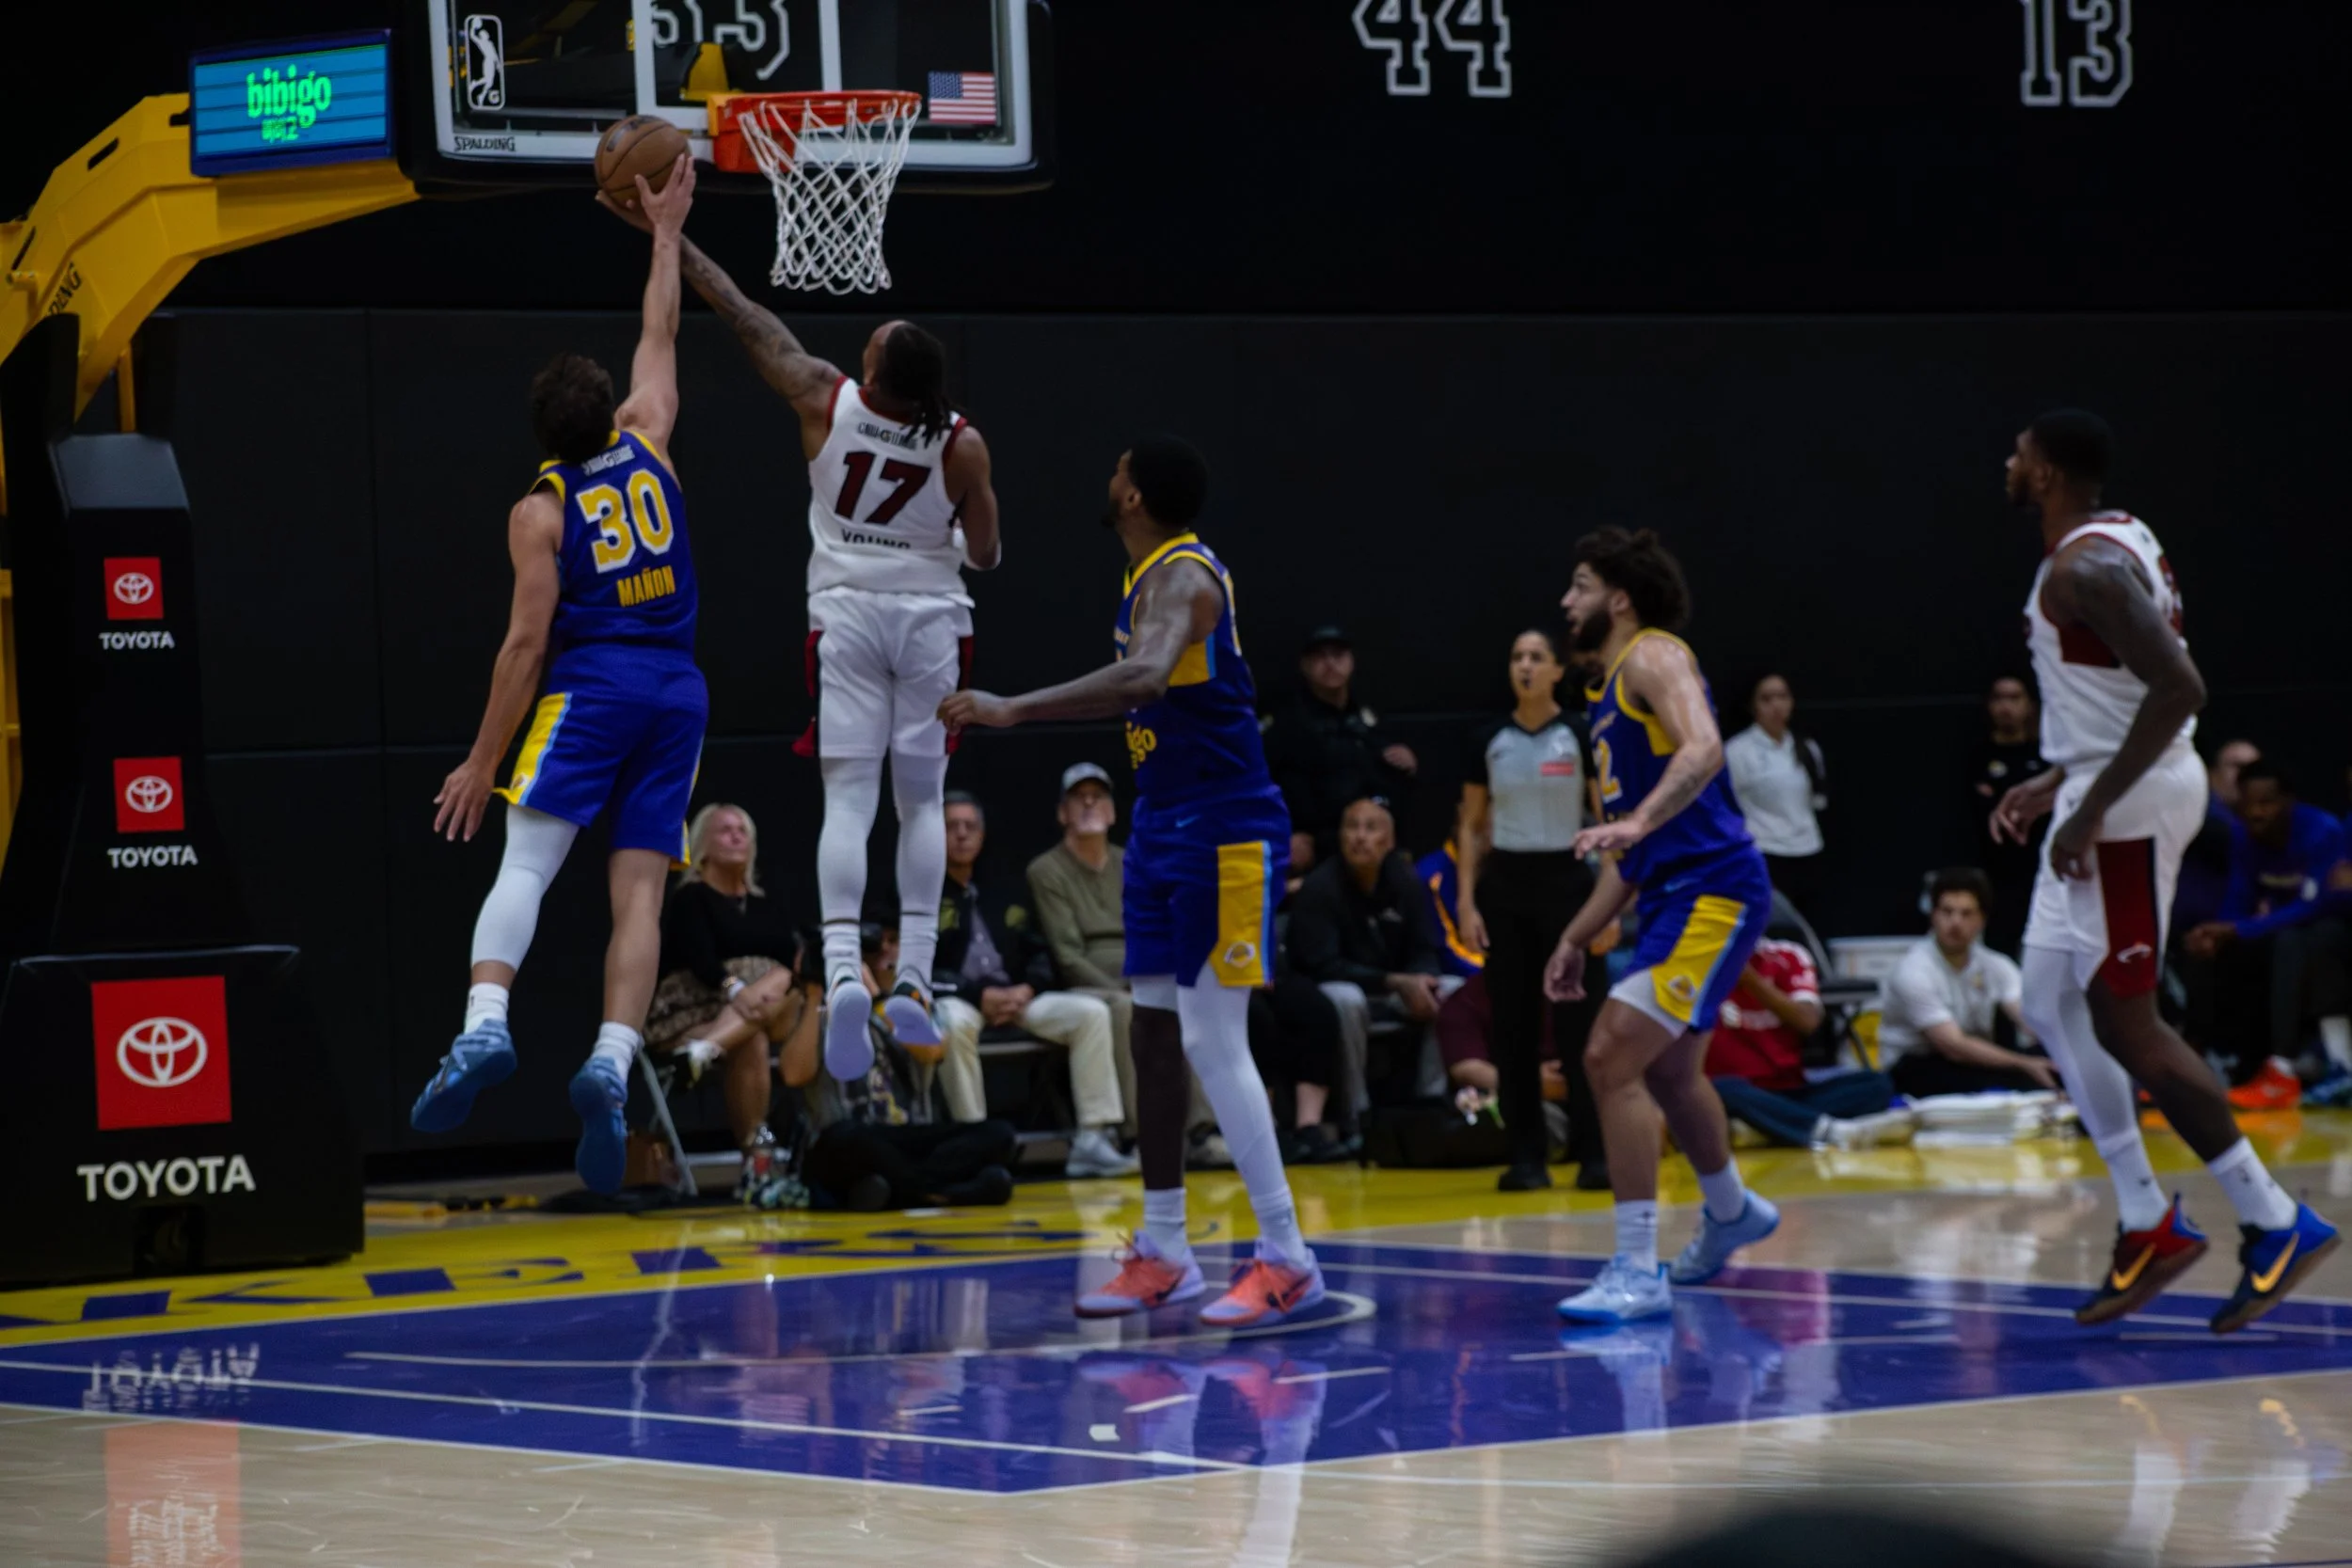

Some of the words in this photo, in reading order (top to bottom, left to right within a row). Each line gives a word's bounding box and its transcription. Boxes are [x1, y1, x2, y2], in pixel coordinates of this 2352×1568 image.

[1351, 0, 1512, 98] 44
[2019, 0, 2134, 108] 13
[246, 64, 332, 129] bibigo
[453, 135, 516, 152] SPALDING
[834, 451, 932, 527] 17
[574, 468, 675, 575] 30
[616, 564, 676, 608] MAÑON
[99, 630, 175, 650] TOYOTA
[106, 845, 199, 869] TOYOTA
[76, 1154, 256, 1202] TOYOTA
